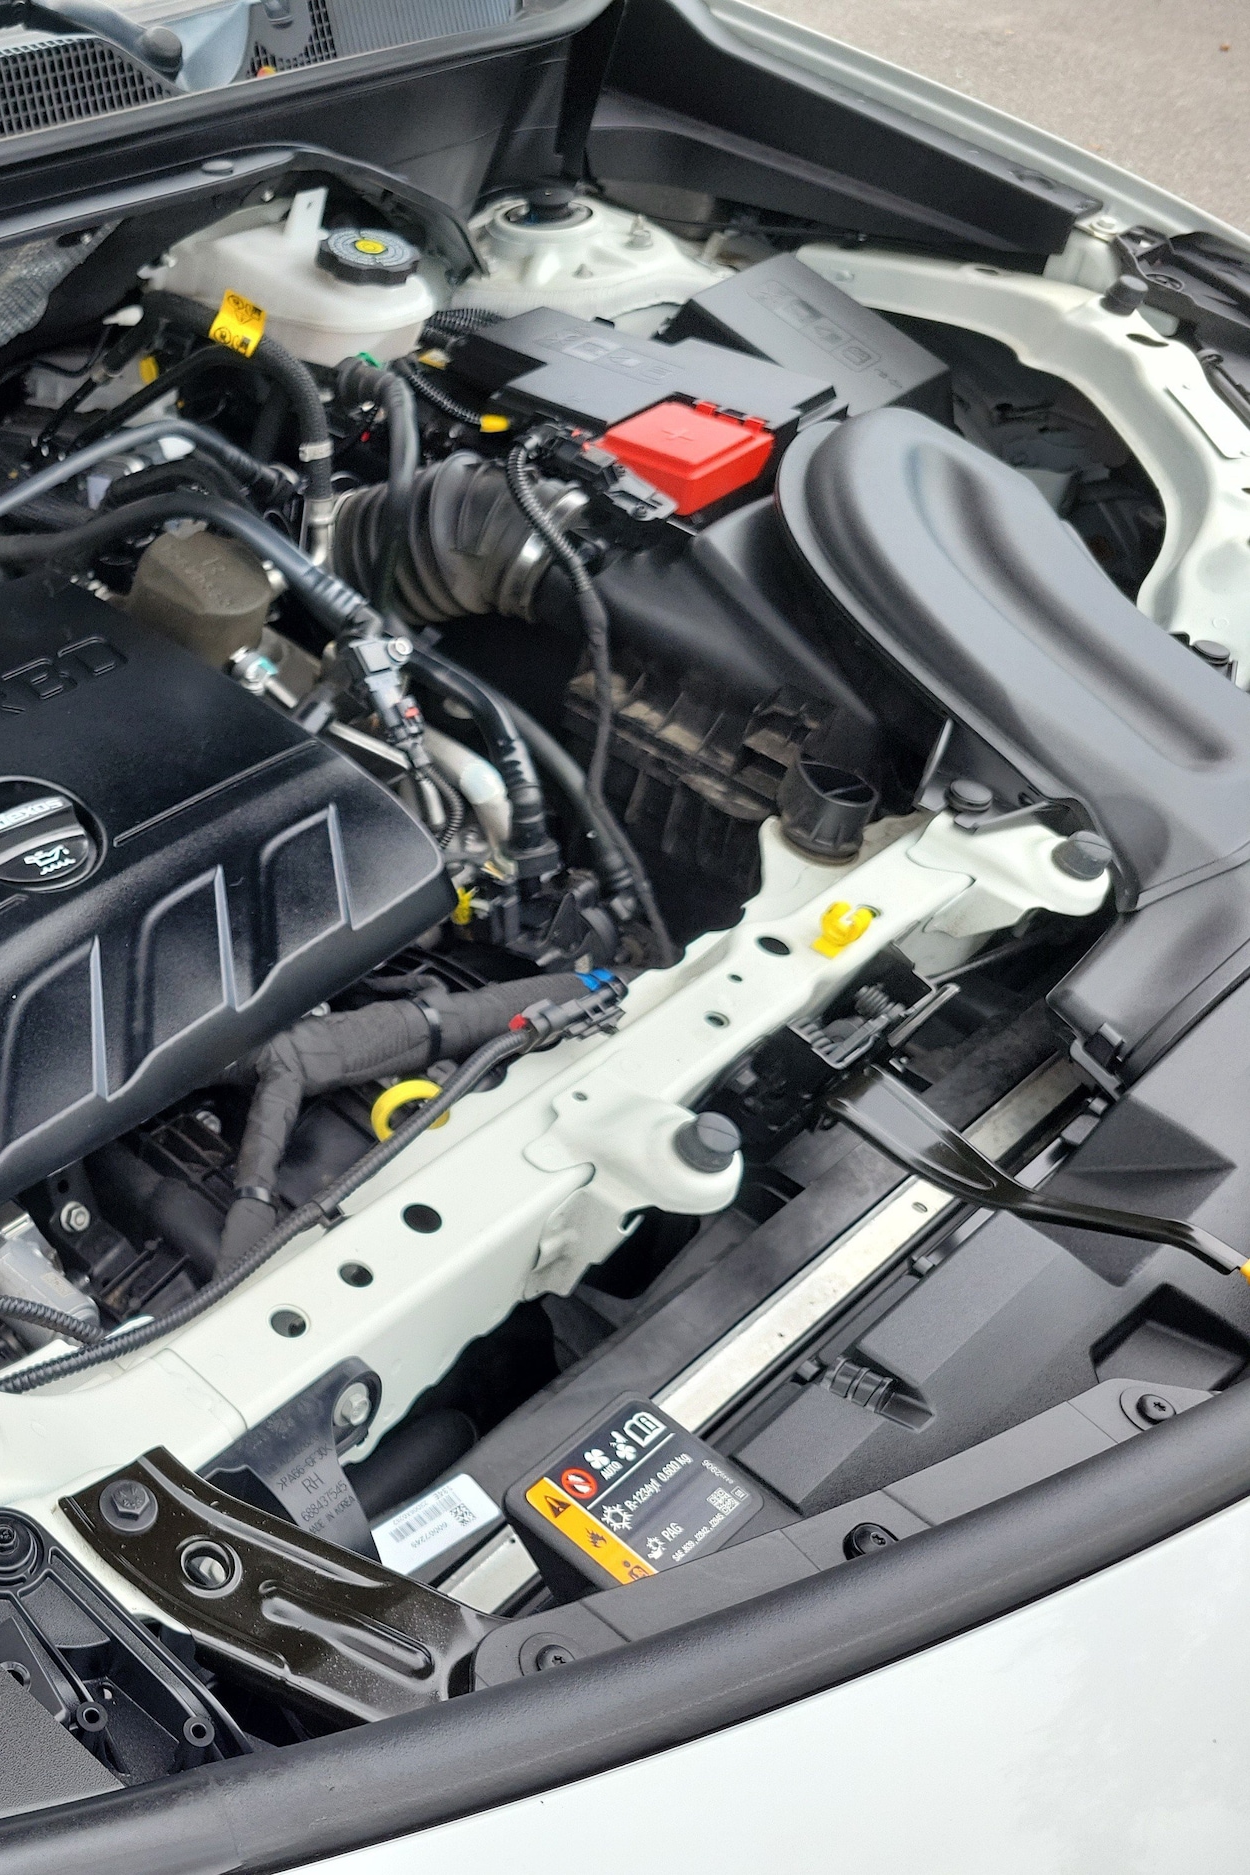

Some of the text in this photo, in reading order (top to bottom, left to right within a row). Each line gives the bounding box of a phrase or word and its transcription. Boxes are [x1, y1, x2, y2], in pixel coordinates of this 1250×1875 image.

[600, 1461, 623, 1480] AUTO
[656, 1460, 682, 1482] 0.600
[674, 1453, 693, 1466] kg
[301, 1472, 327, 1494] RH
[300, 1480, 347, 1522] 688437545
[325, 1511, 335, 1520] IN
[334, 1495, 356, 1515] KOREA
[661, 1522, 684, 1541] PAG
[671, 1549, 685, 1562] SAE
